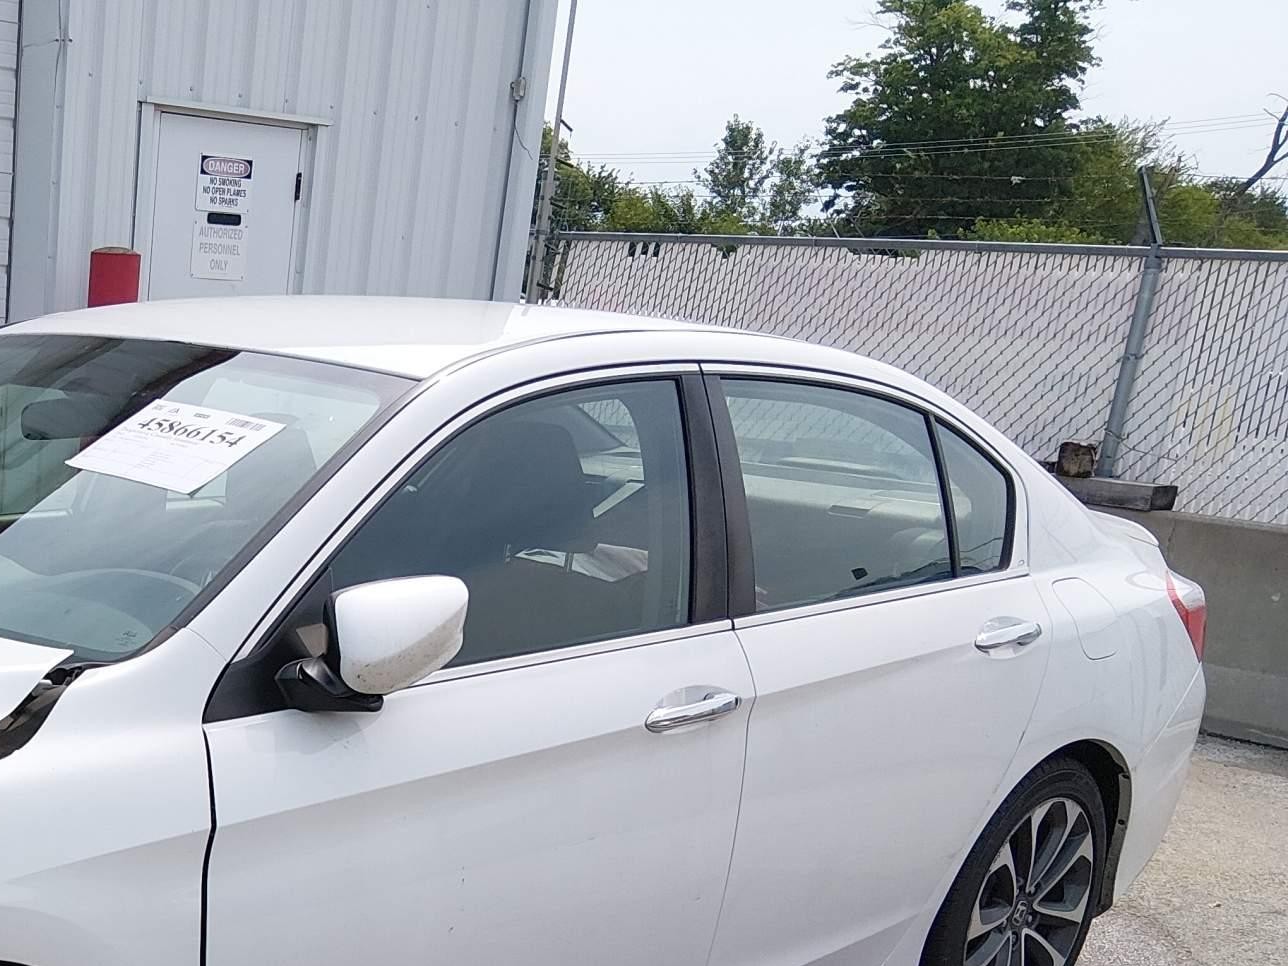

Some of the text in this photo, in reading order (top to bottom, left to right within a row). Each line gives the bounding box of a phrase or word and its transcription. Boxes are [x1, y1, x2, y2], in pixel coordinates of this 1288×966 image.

[208, 160, 245, 174] DANGER
[209, 177, 242, 188] NO SMOKING
[202, 185, 247, 198] NO OPEN FLAMES
[209, 196, 239, 207] NO SPARKS
[199, 226, 244, 241] AUTHORIZED
[199, 242, 241, 256] PERSONNEL
[209, 258, 229, 272] ONLY
[138, 417, 247, 448] 45866154
